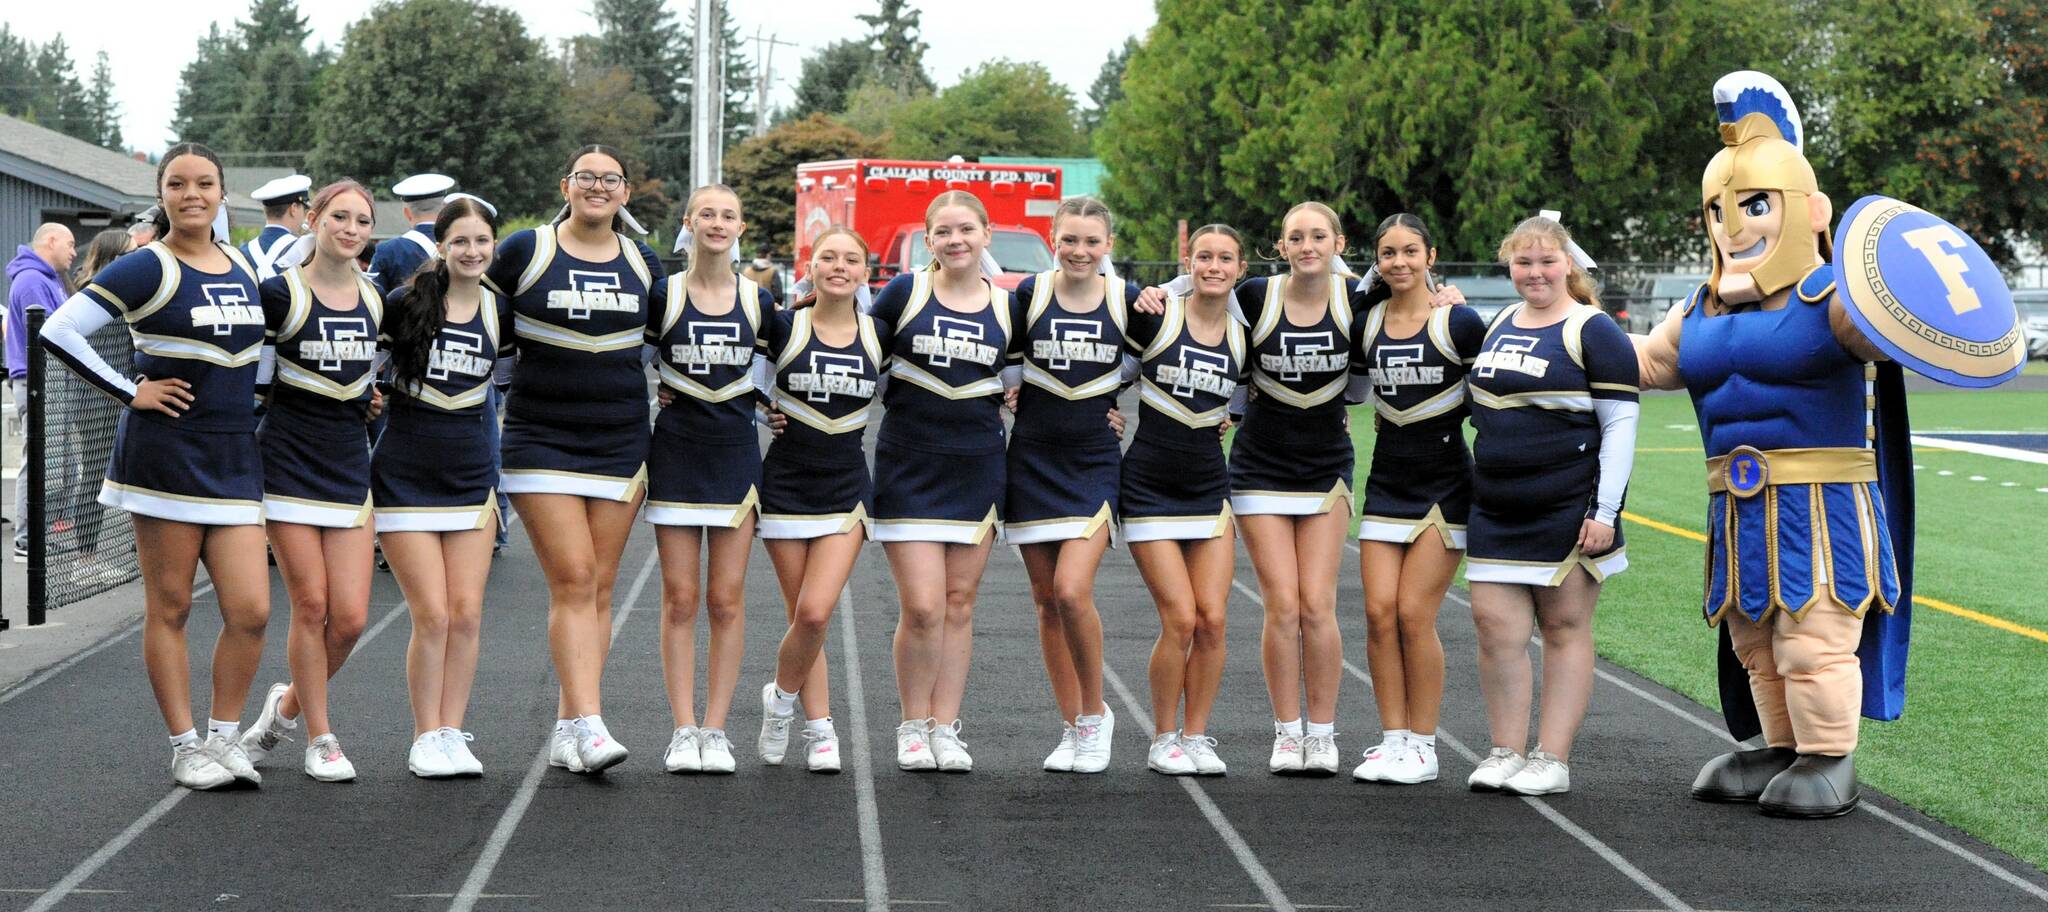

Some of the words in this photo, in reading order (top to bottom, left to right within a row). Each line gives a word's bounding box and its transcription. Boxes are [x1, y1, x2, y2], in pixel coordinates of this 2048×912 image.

[870, 167, 930, 179] CLALLAM
[933, 169, 985, 181] COUNTY
[568, 269, 621, 320] F
[1902, 225, 1981, 316] F
[201, 284, 249, 336] F
[547, 290, 640, 313] SPARTANS
[317, 317, 368, 371] F
[671, 344, 752, 366] SPARTANS
[688, 321, 740, 375] F
[911, 335, 999, 366] SPARTANS
[928, 315, 984, 368] F
[1032, 339, 1119, 362] SPARTANS
[1049, 318, 1103, 370] F
[1260, 352, 1349, 373] SPARTANS
[1280, 331, 1334, 382] F
[1477, 335, 1540, 378] F
[788, 372, 877, 399] SPARTANS
[809, 351, 864, 403] F
[1173, 345, 1229, 398] F
[1375, 344, 1424, 396] F
[1736, 460, 1751, 484] F
